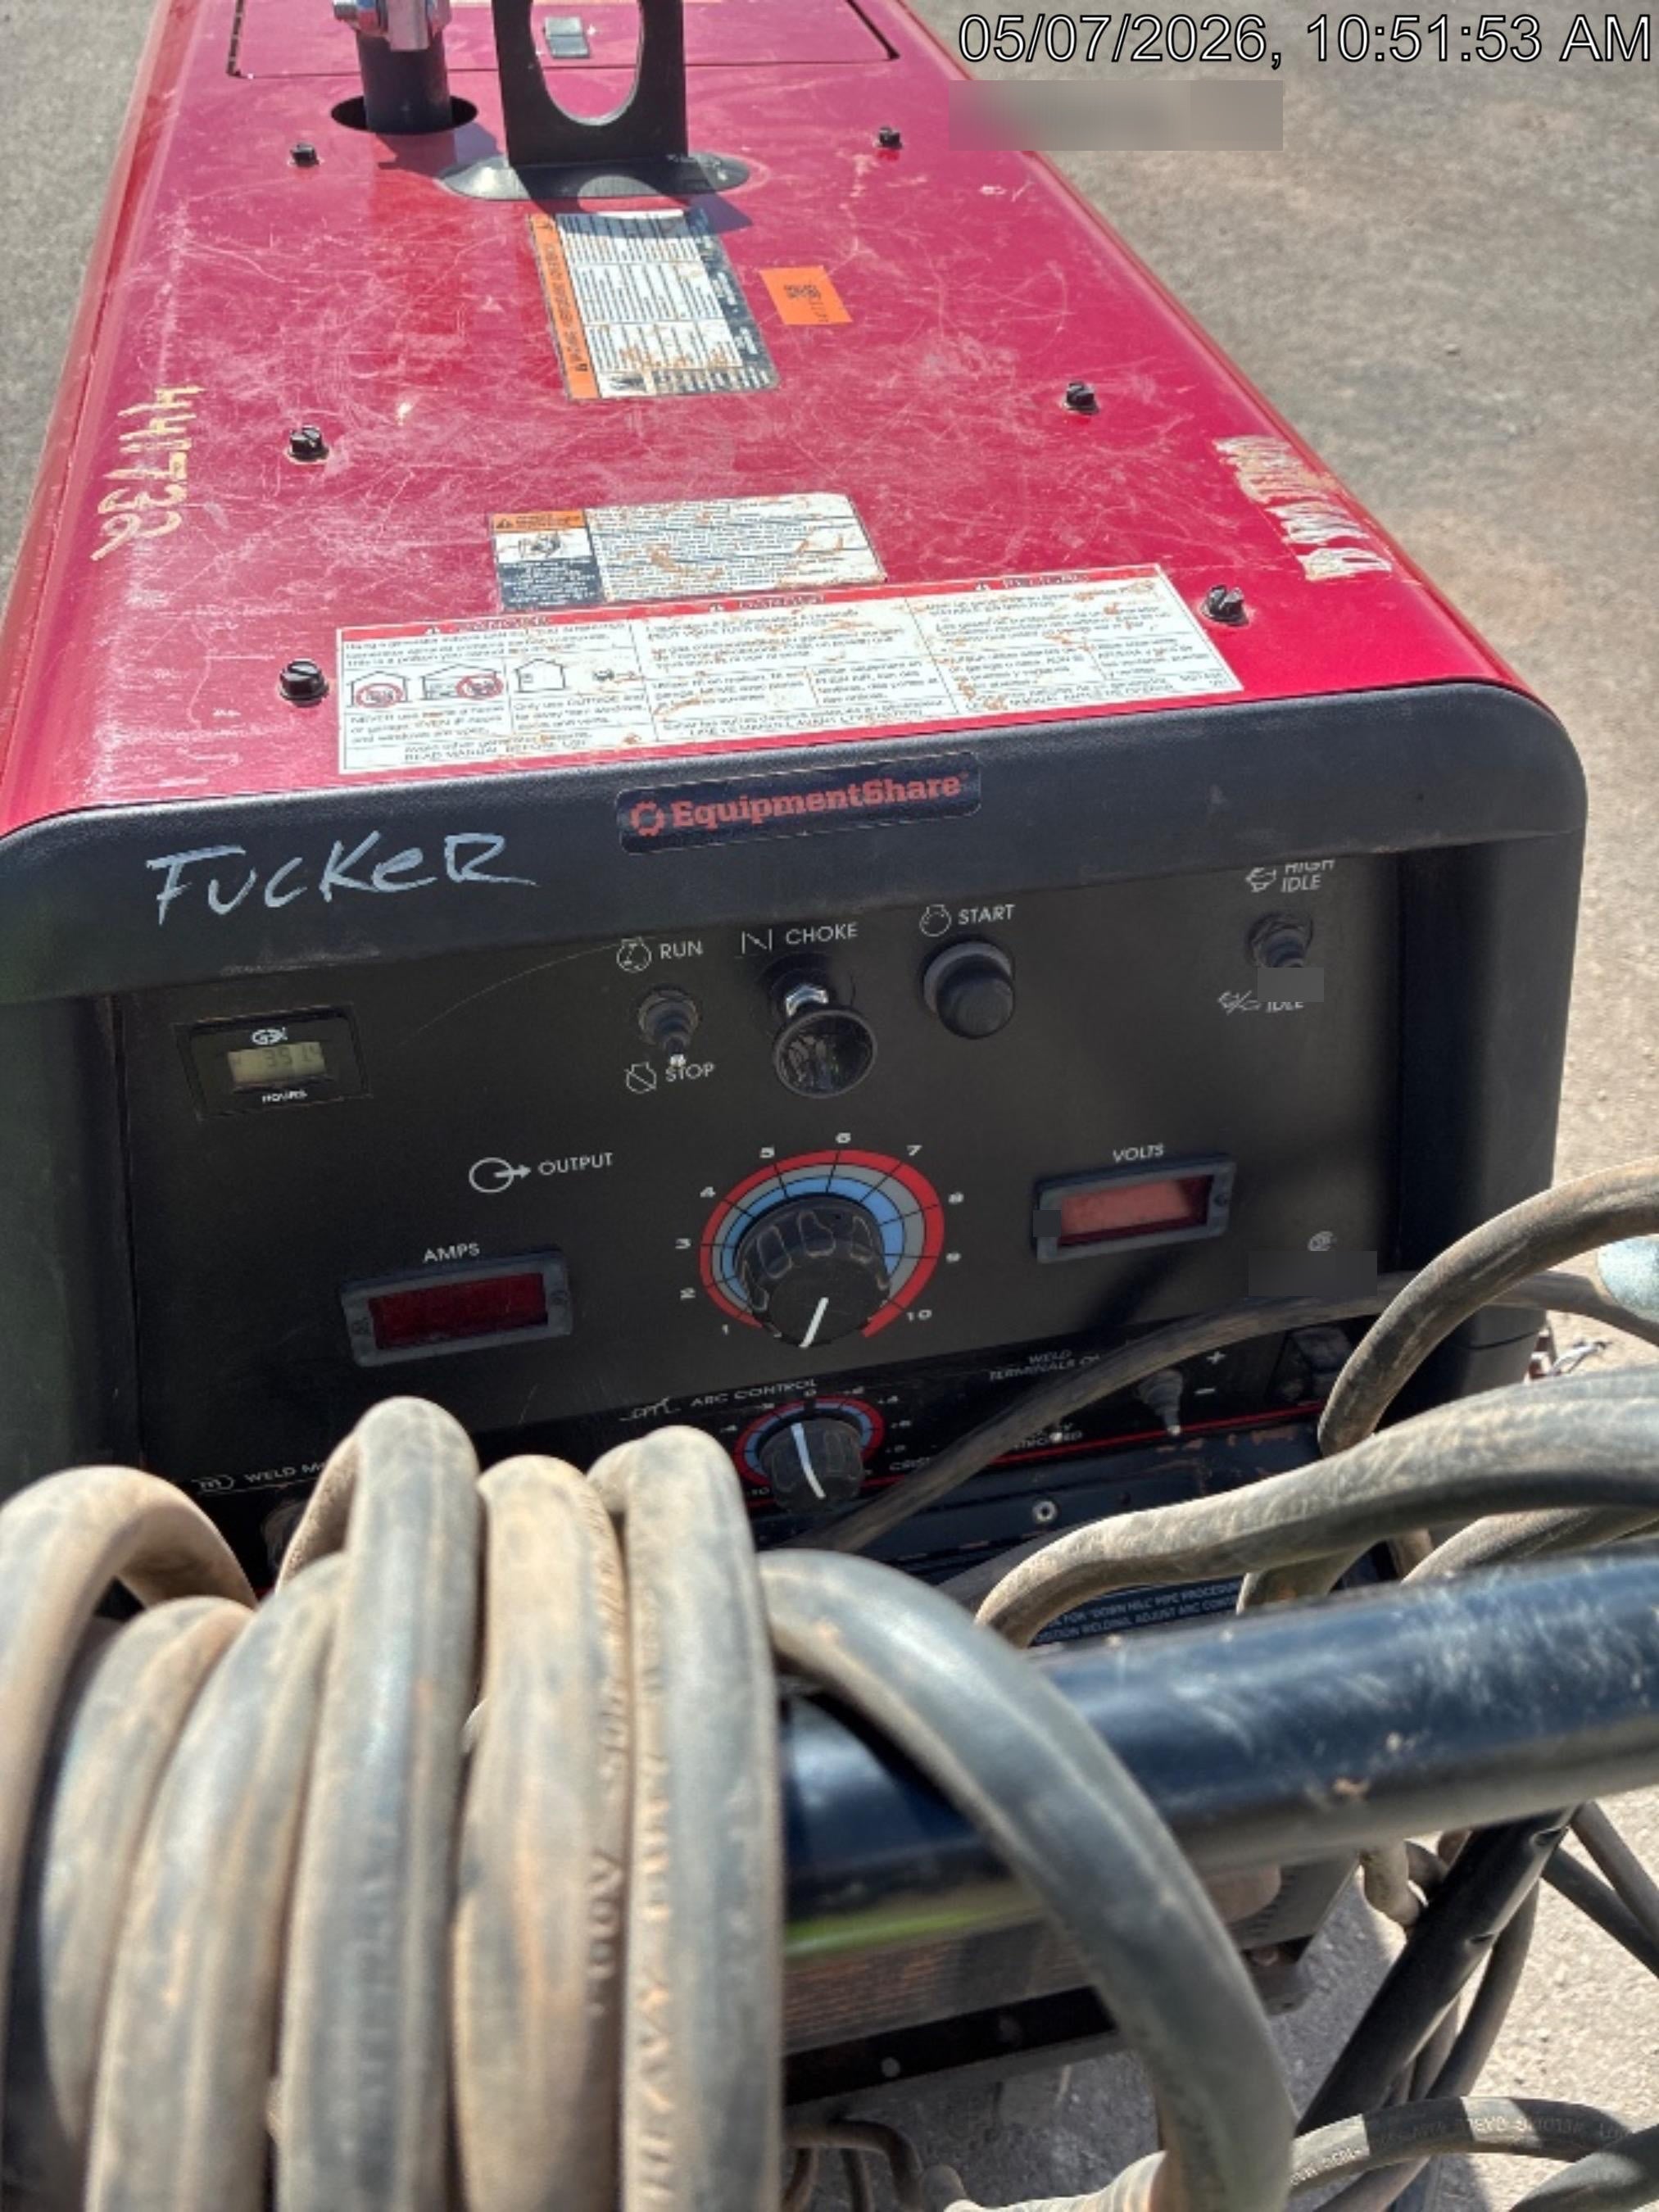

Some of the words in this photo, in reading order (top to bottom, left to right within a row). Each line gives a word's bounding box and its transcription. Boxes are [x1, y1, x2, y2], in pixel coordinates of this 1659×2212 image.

[670, 773, 962, 830] EquipmentShare
[1281, 874, 1321, 893] IDLE
[957, 904, 1016, 926] START
[784, 922, 859, 945] CHOKE
[660, 940, 705, 960] RUN
[664, 1062, 716, 1083] STOP
[836, 1133, 850, 1144] 6
[760, 1147, 775, 1158] 5
[906, 1145, 922, 1157] 7
[1112, 1142, 1165, 1163] VOLTS
[537, 1152, 614, 1176] OUTPUT
[700, 1186, 715, 1199] 4
[421, 1242, 481, 1264] AMPS
[675, 1238, 691, 1249] 3
[680, 1287, 696, 1300] 2
[907, 1309, 932, 1322] 10
[734, 1379, 818, 1400] CONTROL
[245, 1466, 297, 1484] WELD
